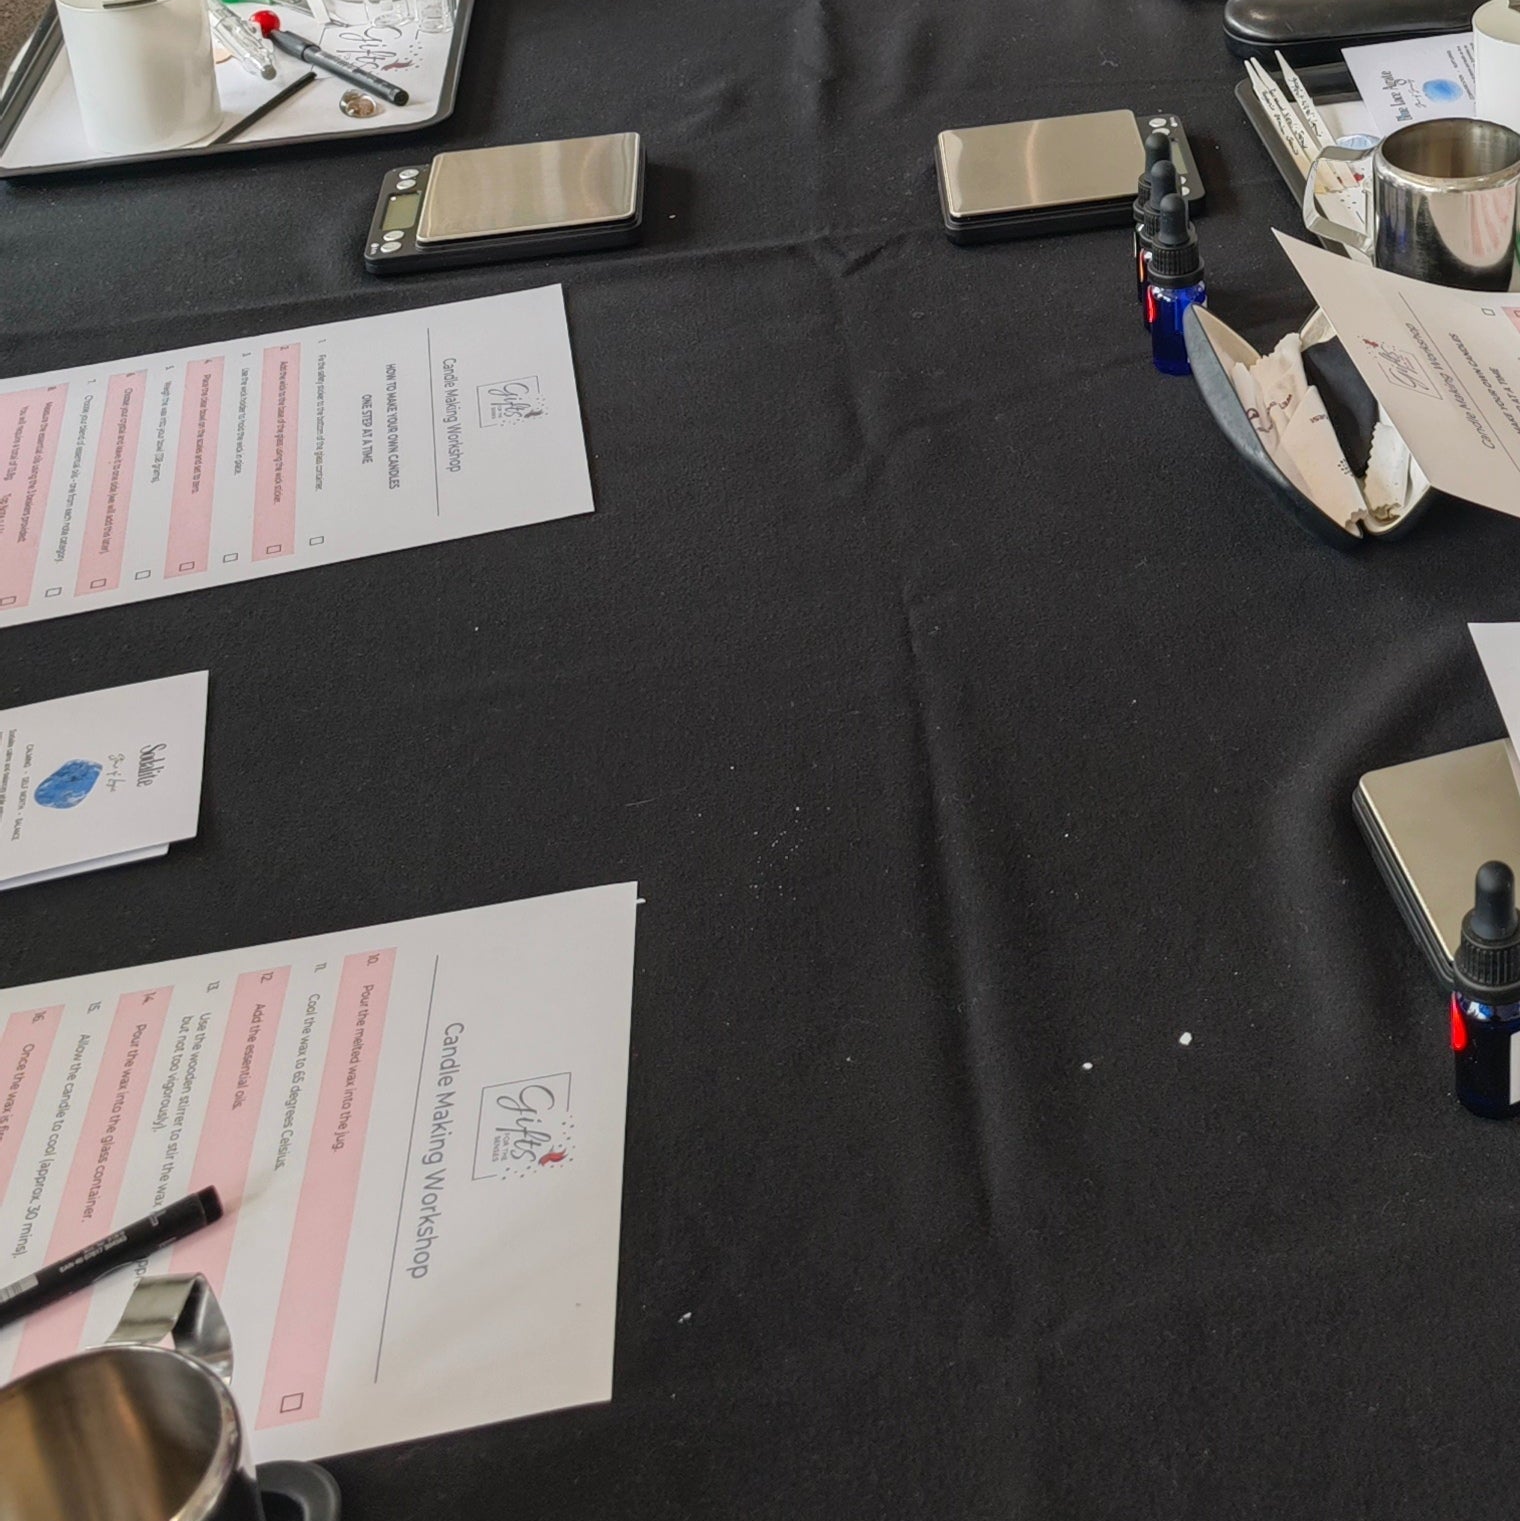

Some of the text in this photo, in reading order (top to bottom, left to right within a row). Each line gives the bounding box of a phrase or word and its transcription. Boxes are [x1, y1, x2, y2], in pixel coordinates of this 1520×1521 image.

[487, 382, 532, 418] Gifts
[1404, 321, 1496, 450] Candle Making Workshop
[360, 393, 373, 464] ONE STEP AT A TIME
[385, 362, 400, 490] HOW TO MAKE YOUR OWN CANDLES
[441, 356, 464, 472] Candle Making Workshop
[136, 743, 167, 787] Sodalite
[250, 1002, 266, 1024] Add
[304, 992, 321, 1016] Cool
[246, 1023, 261, 1043] the
[300, 1016, 316, 1034] the
[72, 1033, 91, 1061] Allow
[293, 1056, 307, 1070] to
[296, 1034, 310, 1057] wax
[330, 952, 381, 1152] 10. Pour the melted wax into the jug.
[65, 1061, 82, 1081] the
[236, 1043, 255, 1089] essential
[290, 1069, 306, 1084] 65
[54, 1081, 75, 1118] candle
[231, 1089, 246, 1111] oils.
[281, 1084, 302, 1129] degrees
[50, 1118, 65, 1132] to
[495, 1084, 555, 1163] Gifts
[43, 1132, 59, 1157] cool
[273, 1128, 294, 1171] Celsius.
[405, 1021, 465, 1279] Candle Making Workshop
[28, 1157, 55, 1204] (approx.
[23, 1203, 41, 1220] 30
[10, 1221, 33, 1259] mins).
